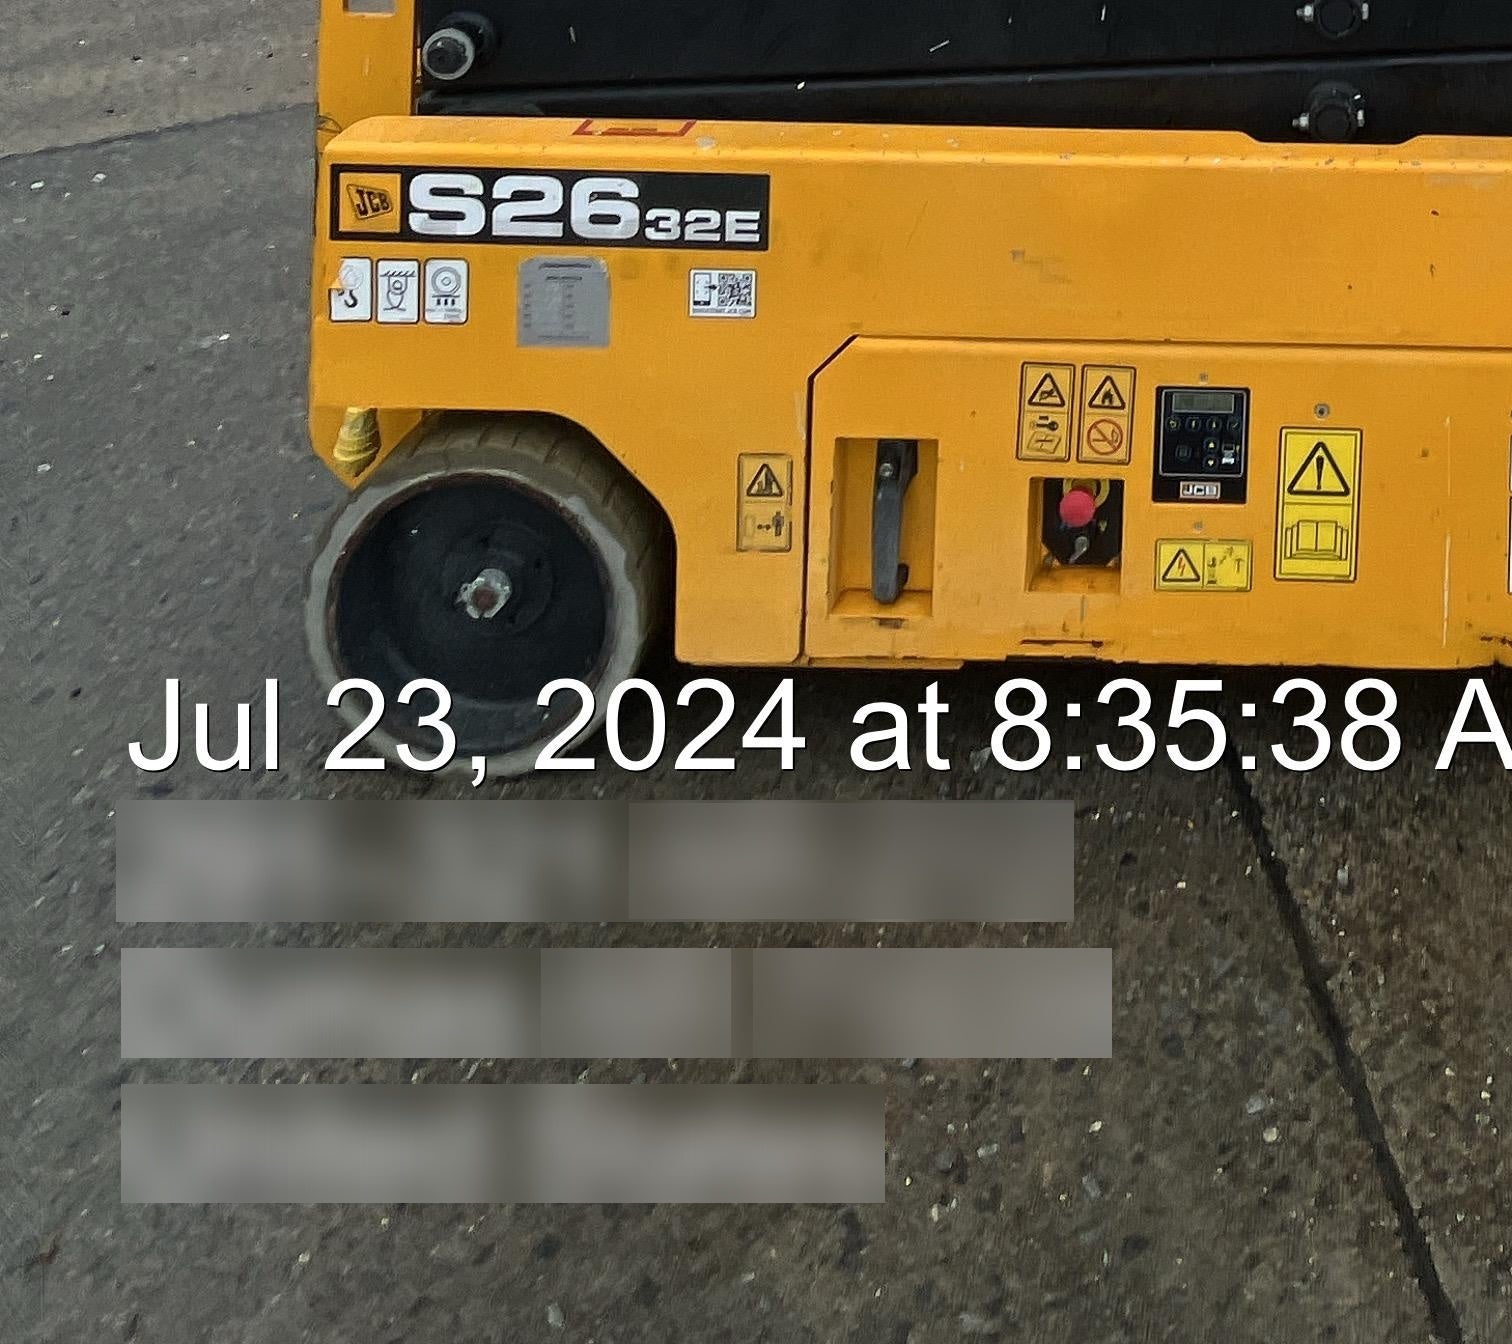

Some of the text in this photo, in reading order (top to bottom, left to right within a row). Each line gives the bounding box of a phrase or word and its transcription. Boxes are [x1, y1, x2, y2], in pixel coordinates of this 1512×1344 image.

[355, 188, 391, 217] JCB
[408, 172, 761, 243] S26 32E
